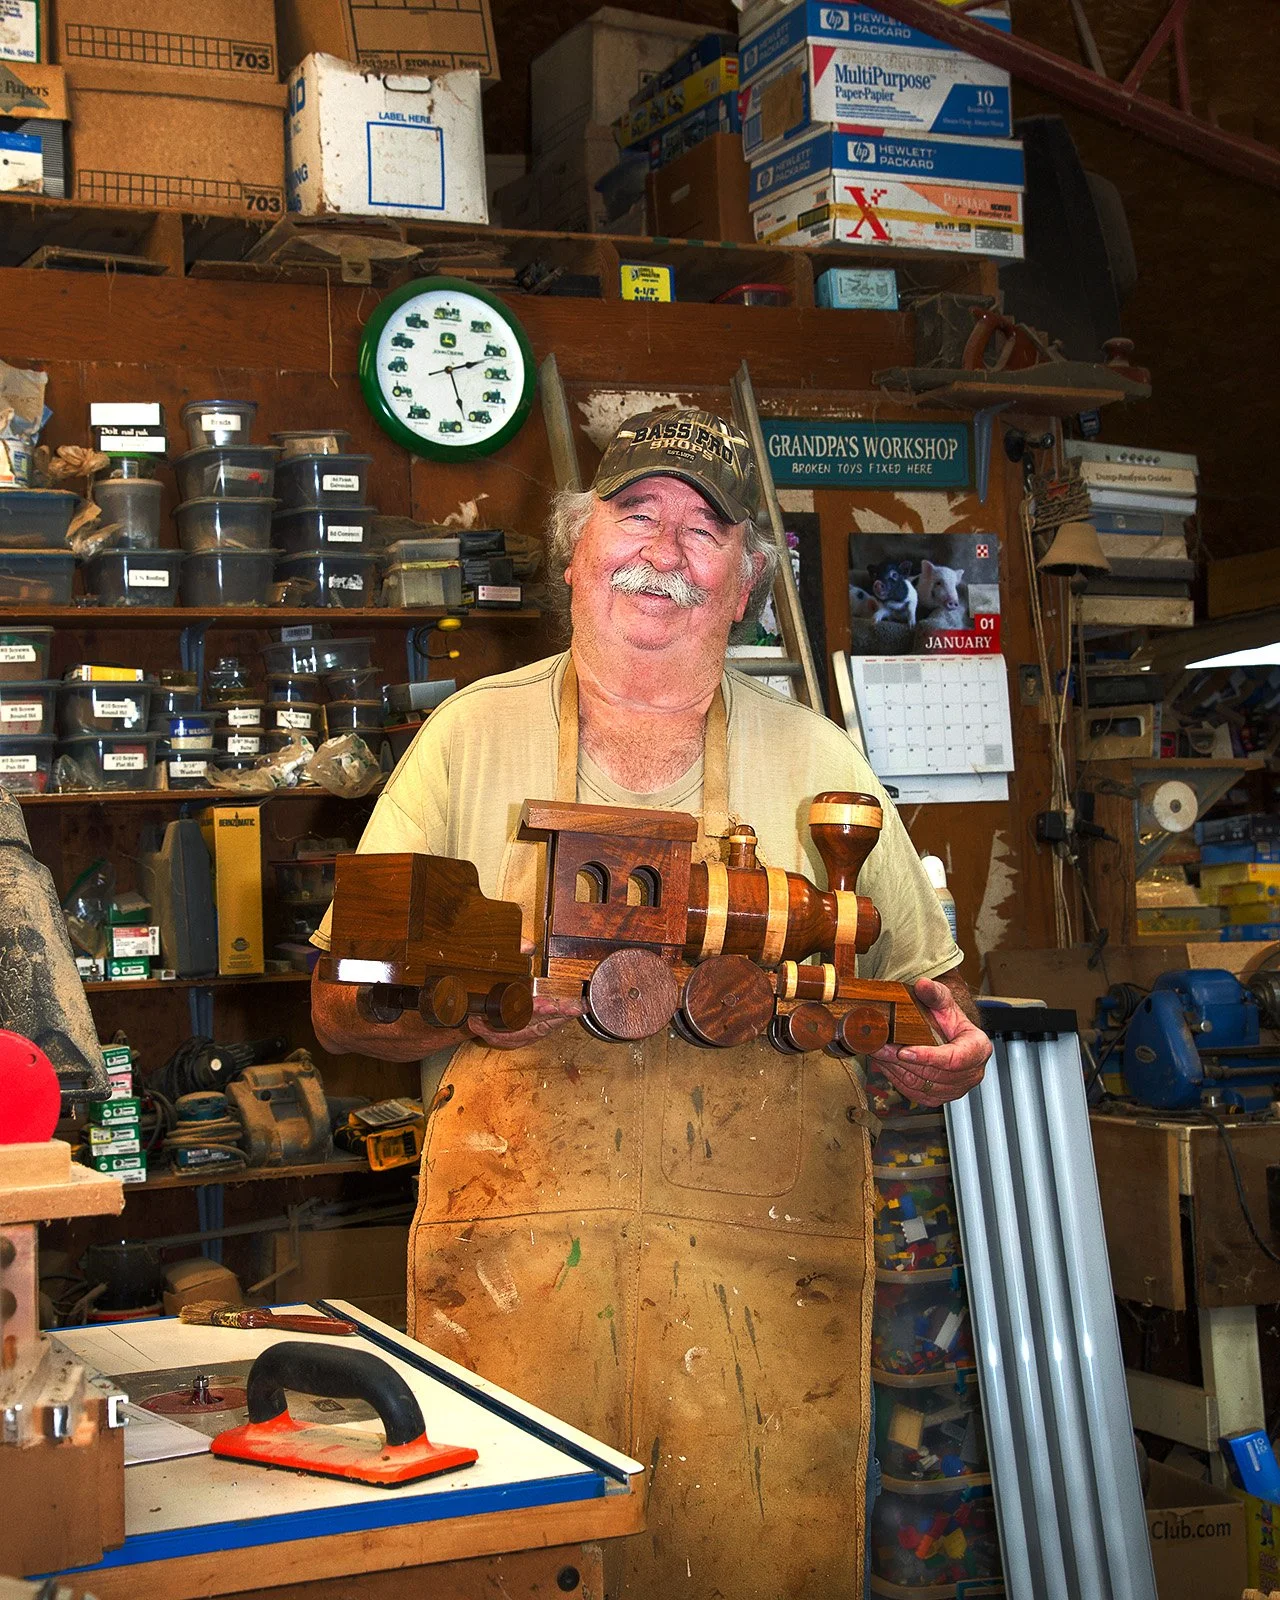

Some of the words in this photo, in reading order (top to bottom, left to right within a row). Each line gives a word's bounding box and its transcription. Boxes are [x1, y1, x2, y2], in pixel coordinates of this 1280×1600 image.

[854, 25, 911, 39] PACKARD
[233, 52, 271, 70] 703
[976, 90, 994, 107] 10
[379, 112, 407, 122] LABEL
[408, 113, 432, 124] HERE
[879, 144, 934, 158] HEWLETT
[879, 156, 934, 170] PACKARD
[244, 196, 281, 212] 703
[631, 423, 692, 446] BASS
[695, 428, 734, 466] PRO
[650, 438, 713, 462] SHOPS
[768, 434, 860, 458] GRANDPA'S
[863, 436, 958, 461] WORKSHOP
[792, 463, 831, 474] BROKEN
[837, 463, 863, 475] TOYS
[869, 463, 901, 475] FIXED
[907, 464, 933, 475] HERE
[979, 617, 995, 631] 01
[925, 636, 992, 650] JANUARY
[1151, 1521, 1232, 1540] Club.com
